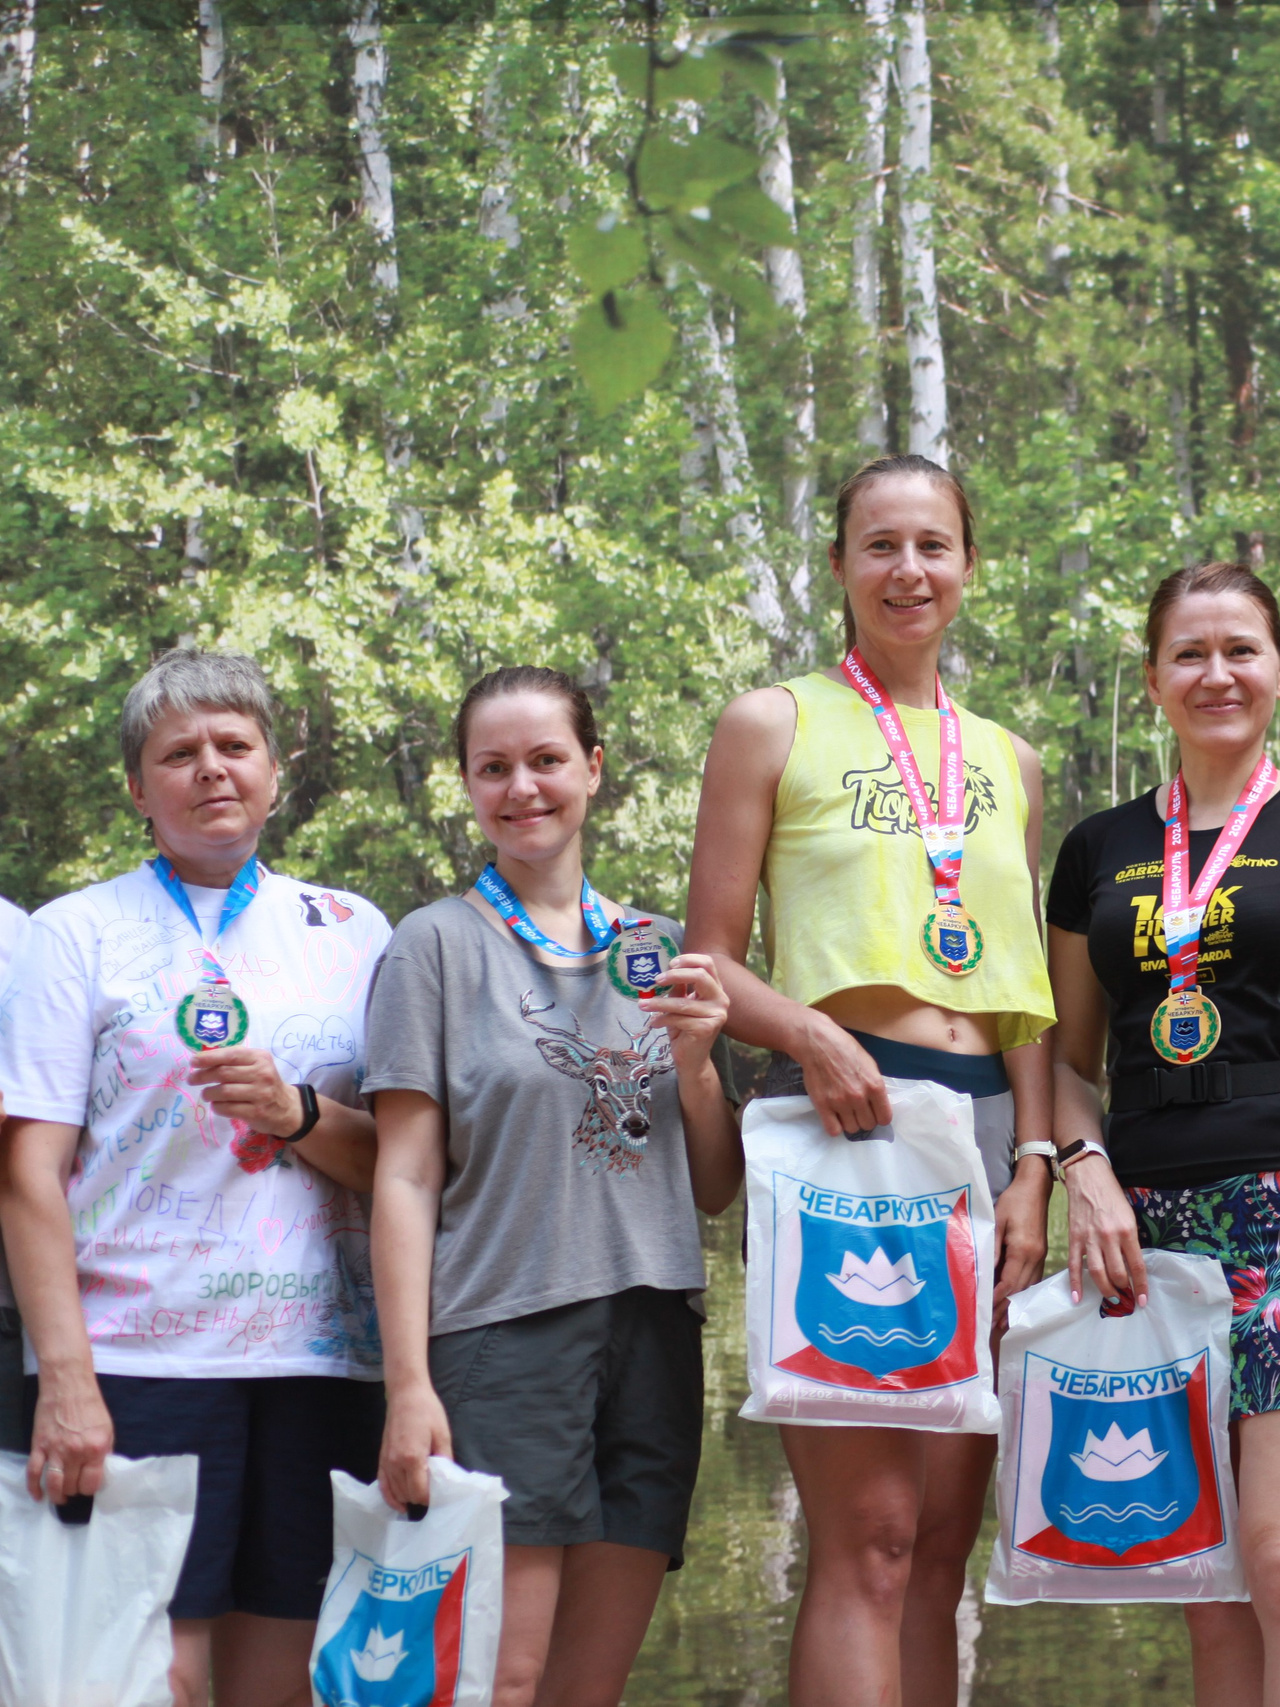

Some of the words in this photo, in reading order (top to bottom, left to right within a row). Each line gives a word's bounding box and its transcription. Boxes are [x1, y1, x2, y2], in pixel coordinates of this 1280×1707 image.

[882, 713, 902, 742] 2024
[946, 717, 957, 745] 2024
[898, 750, 929, 821] ЧЕБАРКУЛЬ
[945, 751, 958, 818] ЧЕБАРКУЛЬ
[1171, 821, 1182, 846] 2024
[1193, 842, 1233, 901] ЧЕБАРКУЛЬ
[1228, 812, 1249, 838] 2024
[1171, 850, 1183, 908] ЧЕБАРКУЛЬ
[621, 944, 663, 955] ЧЕБАРКУЛЬ
[1140, 958, 1168, 972] RIVA
[281, 1031, 356, 1056] СЧАСТЬЯ
[799, 1184, 956, 1223] ЧЕБАРКУЛЬ
[799, 1388, 834, 1400] 2024
[1048, 1364, 1193, 1399] ЧЕБАРКУЛЬ
[842, 1391, 929, 1408] ЭСТАФЕТЫ
